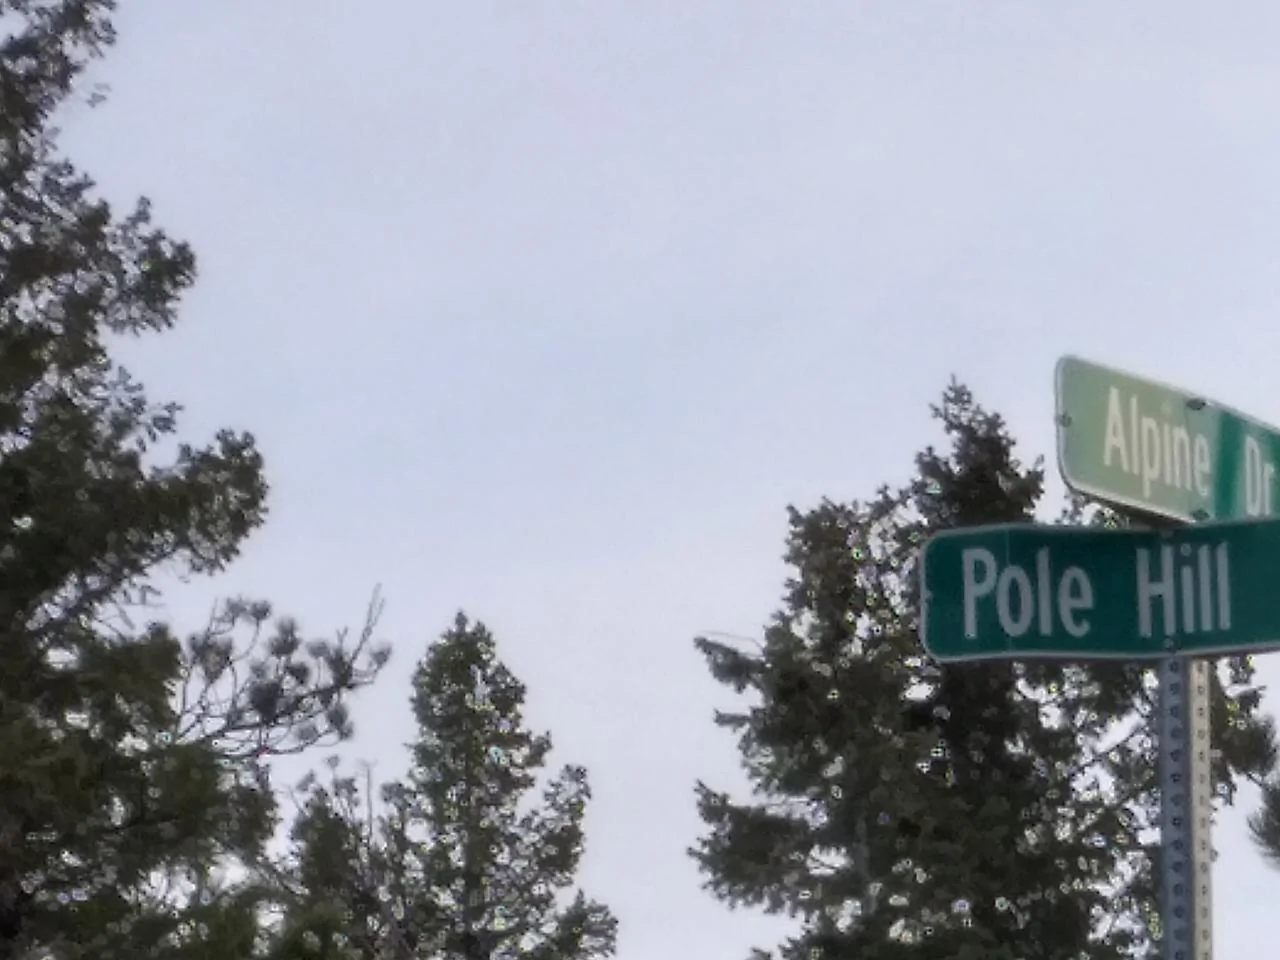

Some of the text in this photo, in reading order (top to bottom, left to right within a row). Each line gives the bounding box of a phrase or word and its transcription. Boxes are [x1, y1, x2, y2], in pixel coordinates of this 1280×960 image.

[1104, 386, 1276, 517] Alpine Dr
[962, 546, 1094, 641] Pole
[1136, 540, 1232, 638] Hill
